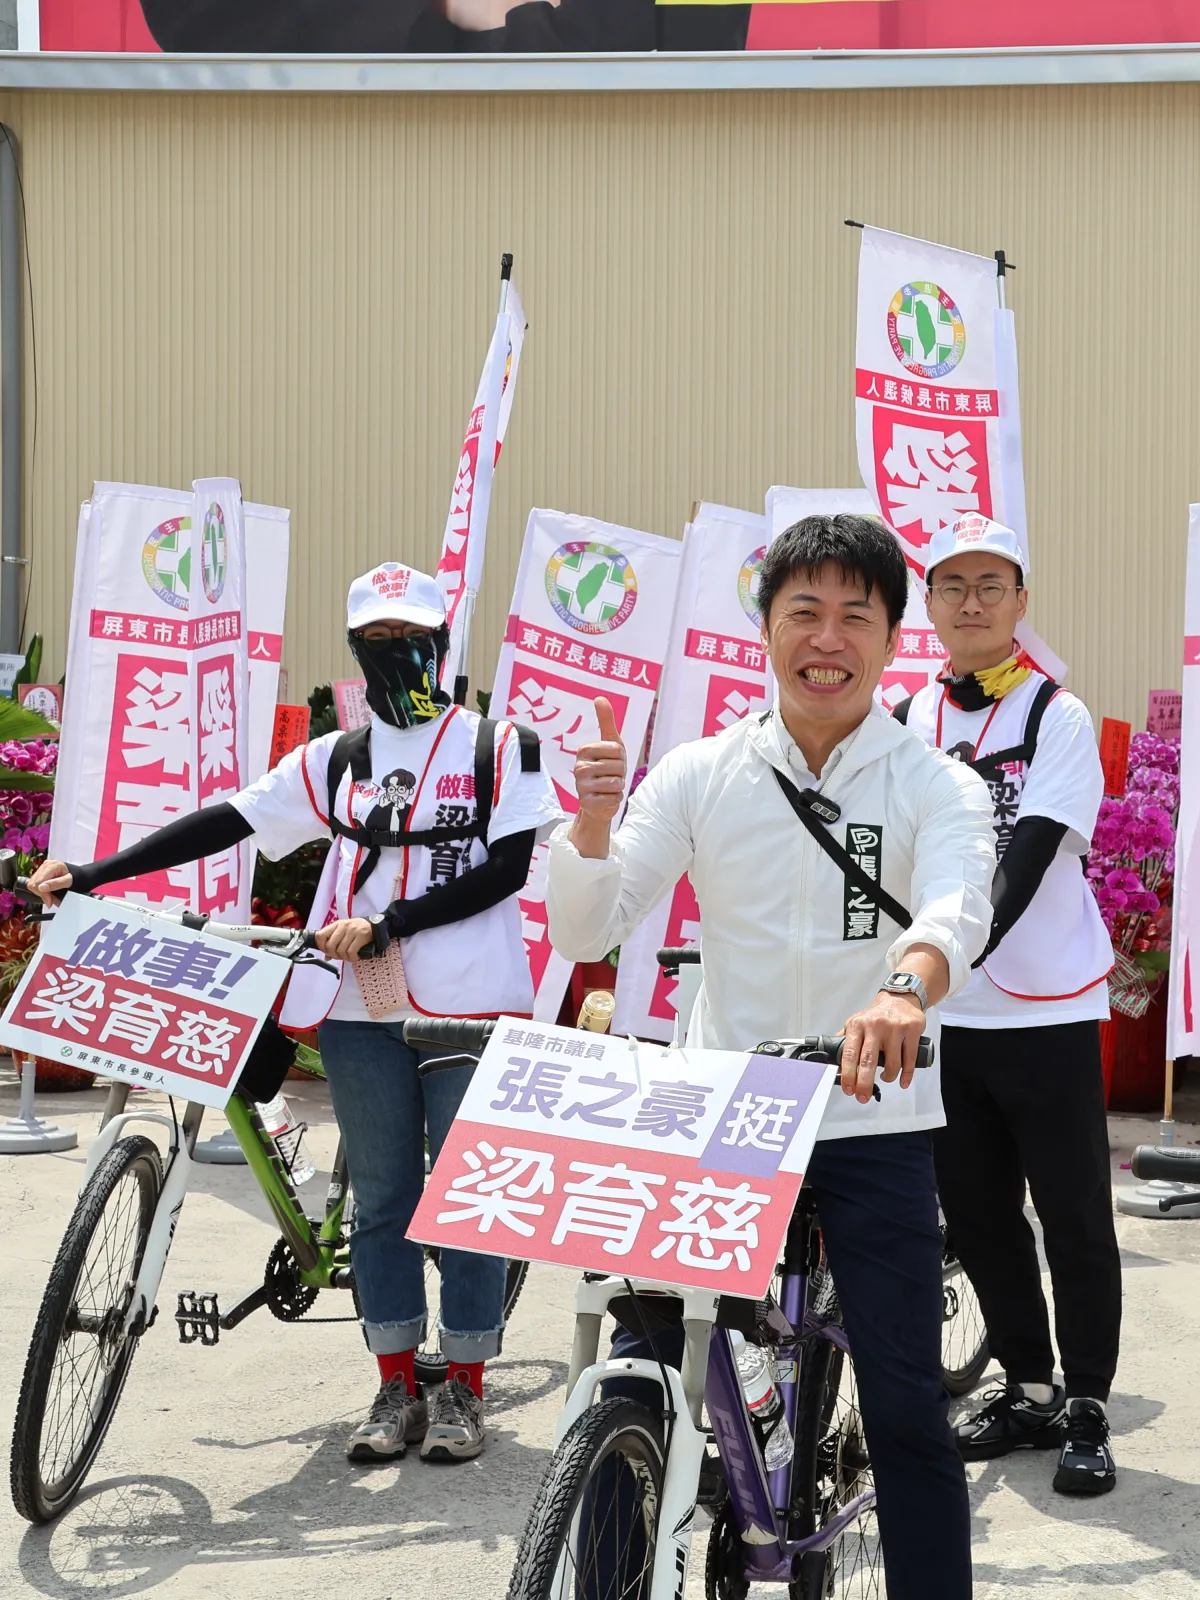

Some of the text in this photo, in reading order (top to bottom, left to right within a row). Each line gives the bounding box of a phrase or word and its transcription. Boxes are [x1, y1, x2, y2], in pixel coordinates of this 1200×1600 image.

[371, 569, 411, 586] 做事!
[518, 627, 651, 685] 東市長候選人
[696, 634, 764, 668] 屏東市
[435, 774, 476, 800] 做事
[65, 918, 259, 1000] 做事!
[25, 966, 242, 1075] 梁育慈
[502, 1027, 606, 1061] 基隆市議員
[489, 1056, 798, 1152] 張之豪 挺
[436, 1140, 772, 1273] 梁育慈
